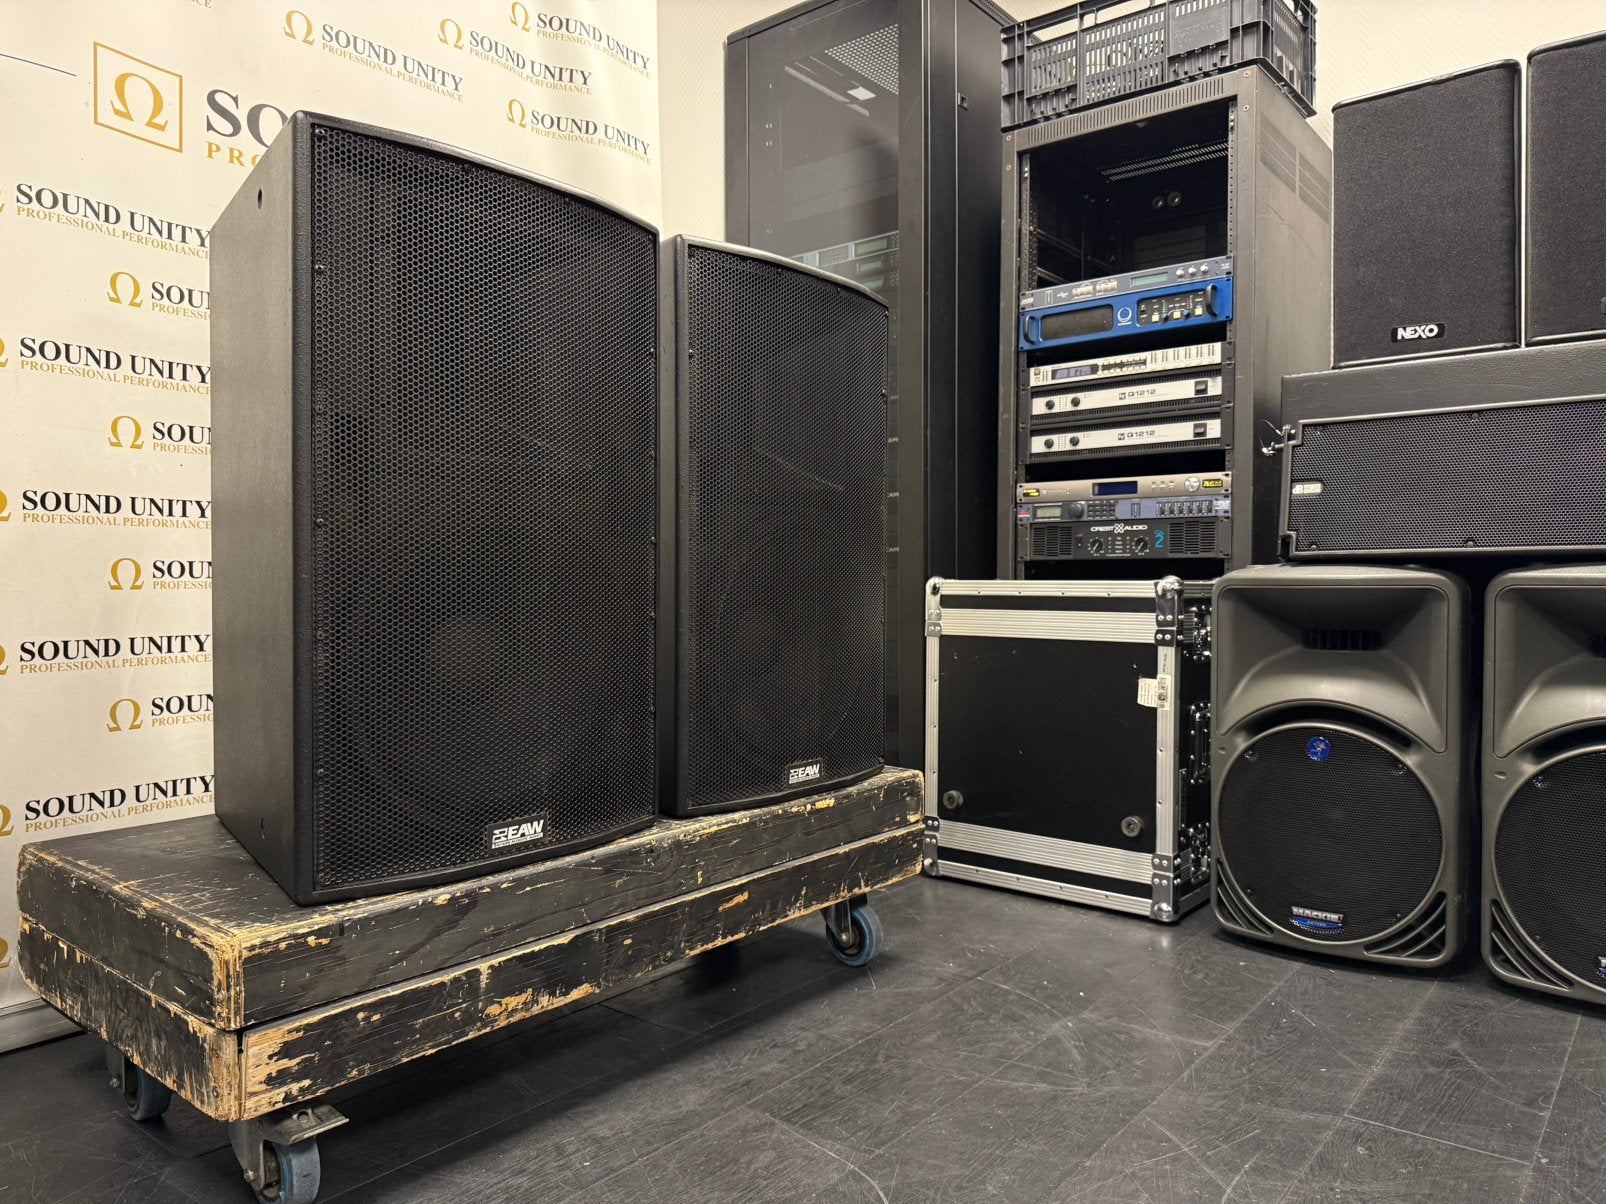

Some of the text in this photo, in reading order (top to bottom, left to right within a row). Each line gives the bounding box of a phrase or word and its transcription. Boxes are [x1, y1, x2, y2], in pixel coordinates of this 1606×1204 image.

[537, 13, 649, 70] SOUND UNITY
[537, 29, 650, 78] PROFESSIONAL PERFORMANCE
[322, 24, 463, 92] SOUND UNITY
[470, 31, 592, 86] SOUND UNITY
[470, 47, 592, 95] PROFESSIONAL PERFORMANCE
[322, 43, 463, 102] PROFESSIONAL PERFORMANCE
[531, 110, 649, 156] SOUND UNITY
[531, 126, 650, 165] PROFESSIONAL PERFORMANCE
[16, 183, 210, 248] SOUND UNITY
[16, 206, 119, 238] PROFESSIONAL
[152, 281, 210, 310] SOU
[152, 302, 210, 320] PROFESSI
[1397, 324, 1439, 340] NEXO
[20, 337, 210, 384] SOUND UNITY
[20, 359, 119, 383] PROFESSIONAL
[1127, 389, 1156, 397] Q1212
[1126, 430, 1155, 438] Q1212
[153, 442, 211, 455] PROFESSI
[22, 490, 211, 518] SOUND UNITY
[23, 512, 211, 529] PROFESSIONAL PERFORMANCE
[20, 634, 210, 662] SOUND UNITY
[20, 653, 211, 674] PROFESSIONAL PERFORMANCE
[799, 763, 820, 778] EAW
[25, 775, 214, 821] SOUND UNITY
[25, 809, 125, 833] PROFESSIONAL
[508, 819, 544, 839] EAW
